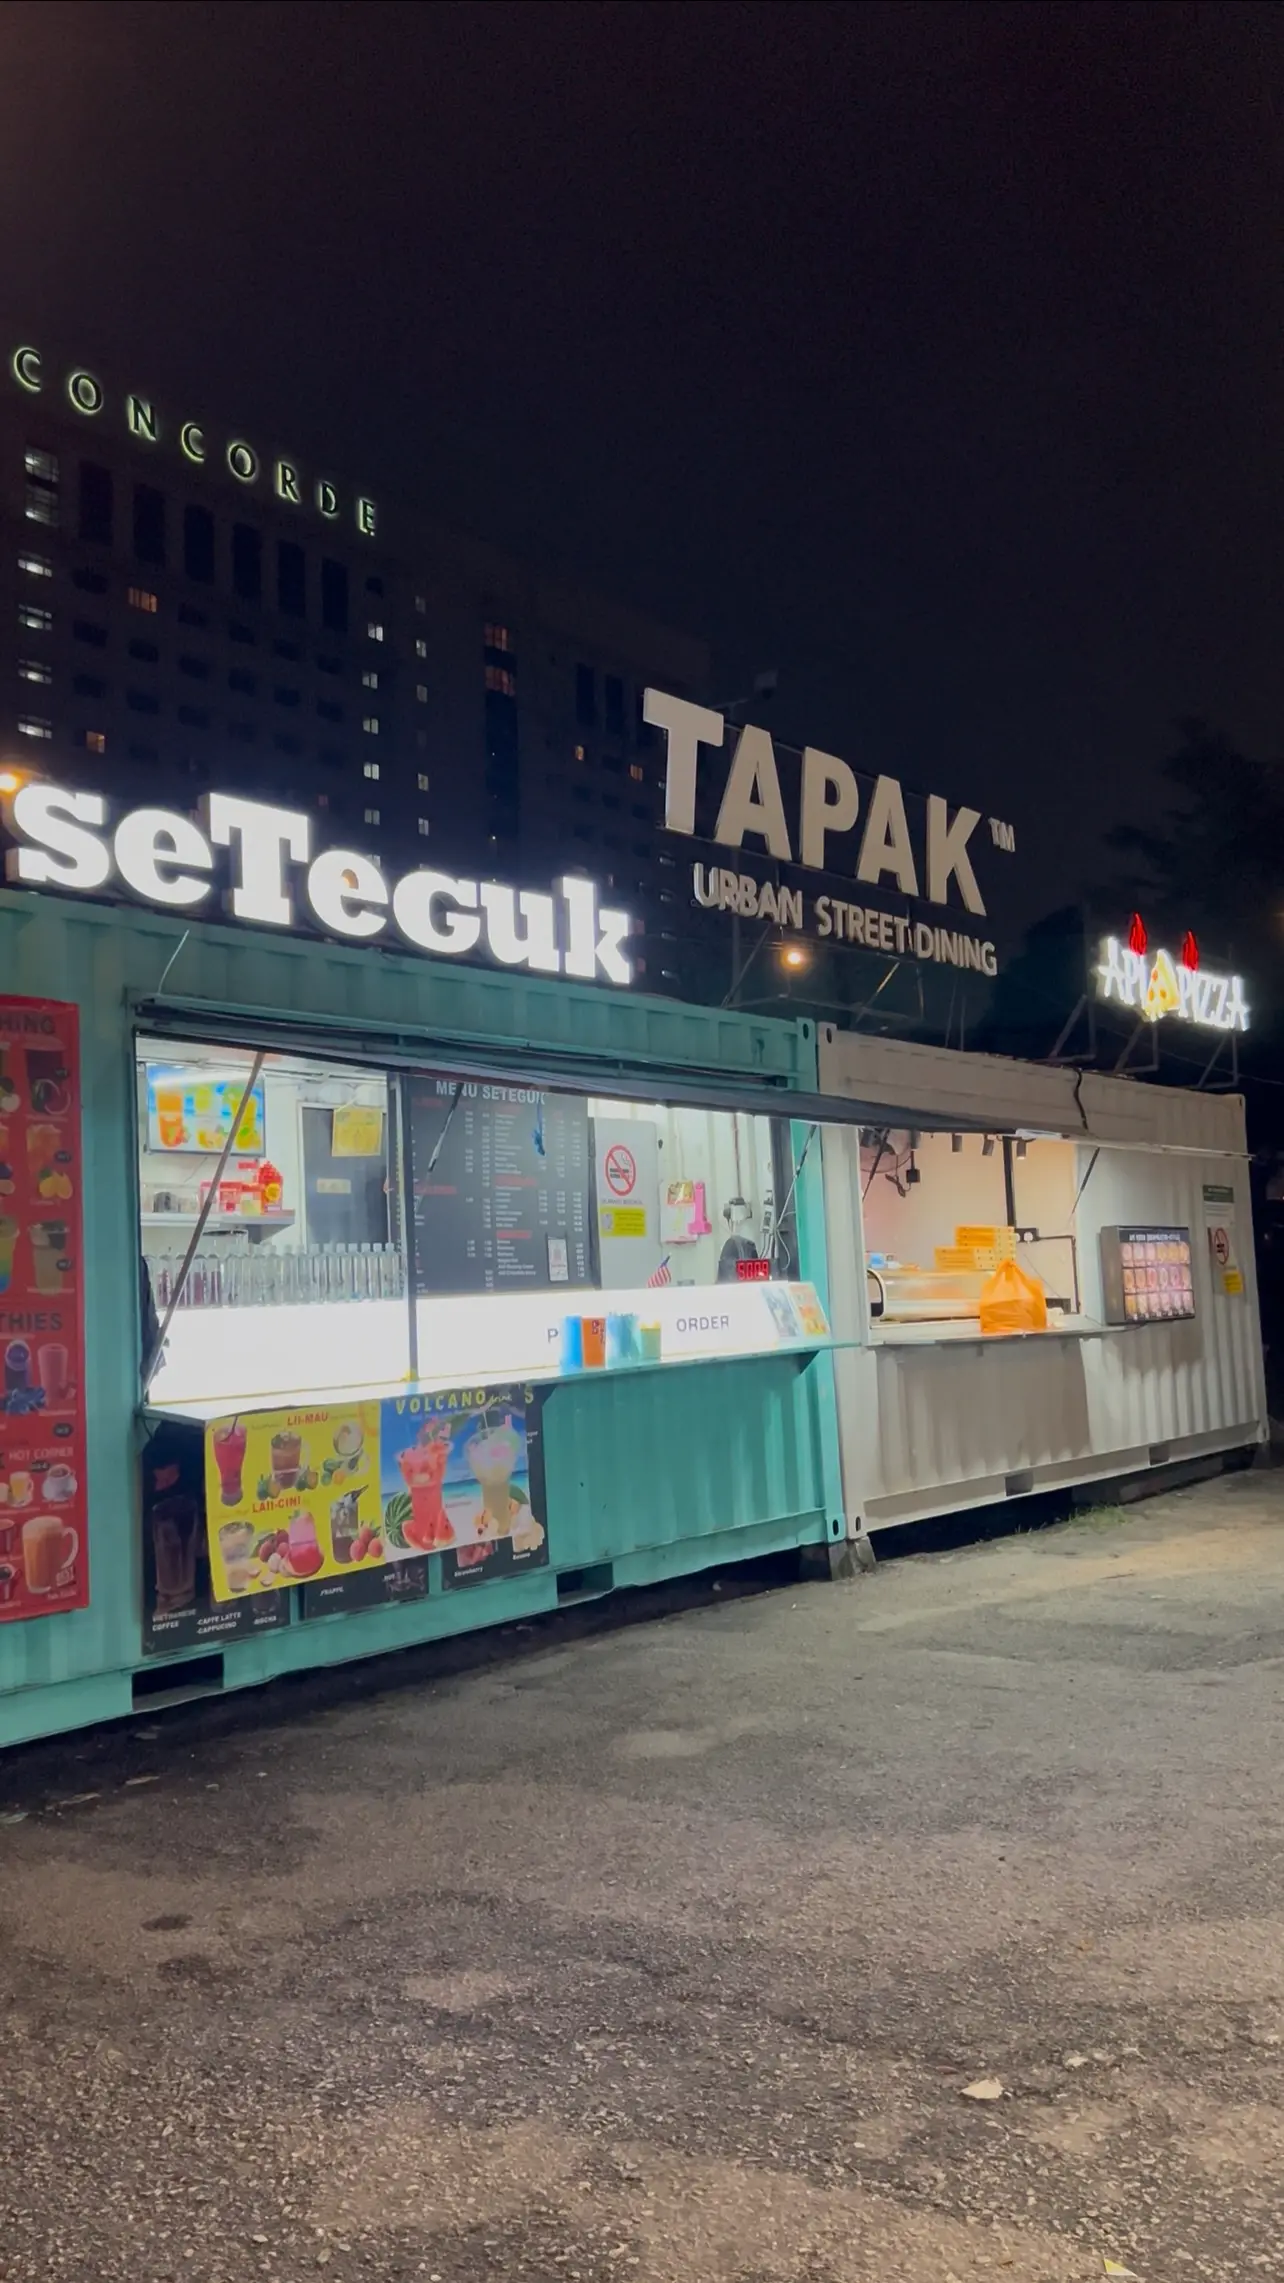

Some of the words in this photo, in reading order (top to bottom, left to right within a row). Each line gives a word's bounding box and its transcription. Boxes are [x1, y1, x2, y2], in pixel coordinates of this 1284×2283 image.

[13, 347, 376, 537] CONCORDE
[643, 687, 987, 917] TAPAK
[987, 816, 1016, 853] TM
[693, 862, 803, 930] URBAN
[814, 895, 909, 954] STREET
[914, 923, 998, 978] DINING
[676, 1315, 730, 1332] ORDER
[395, 1389, 486, 1415] VOLCANO
